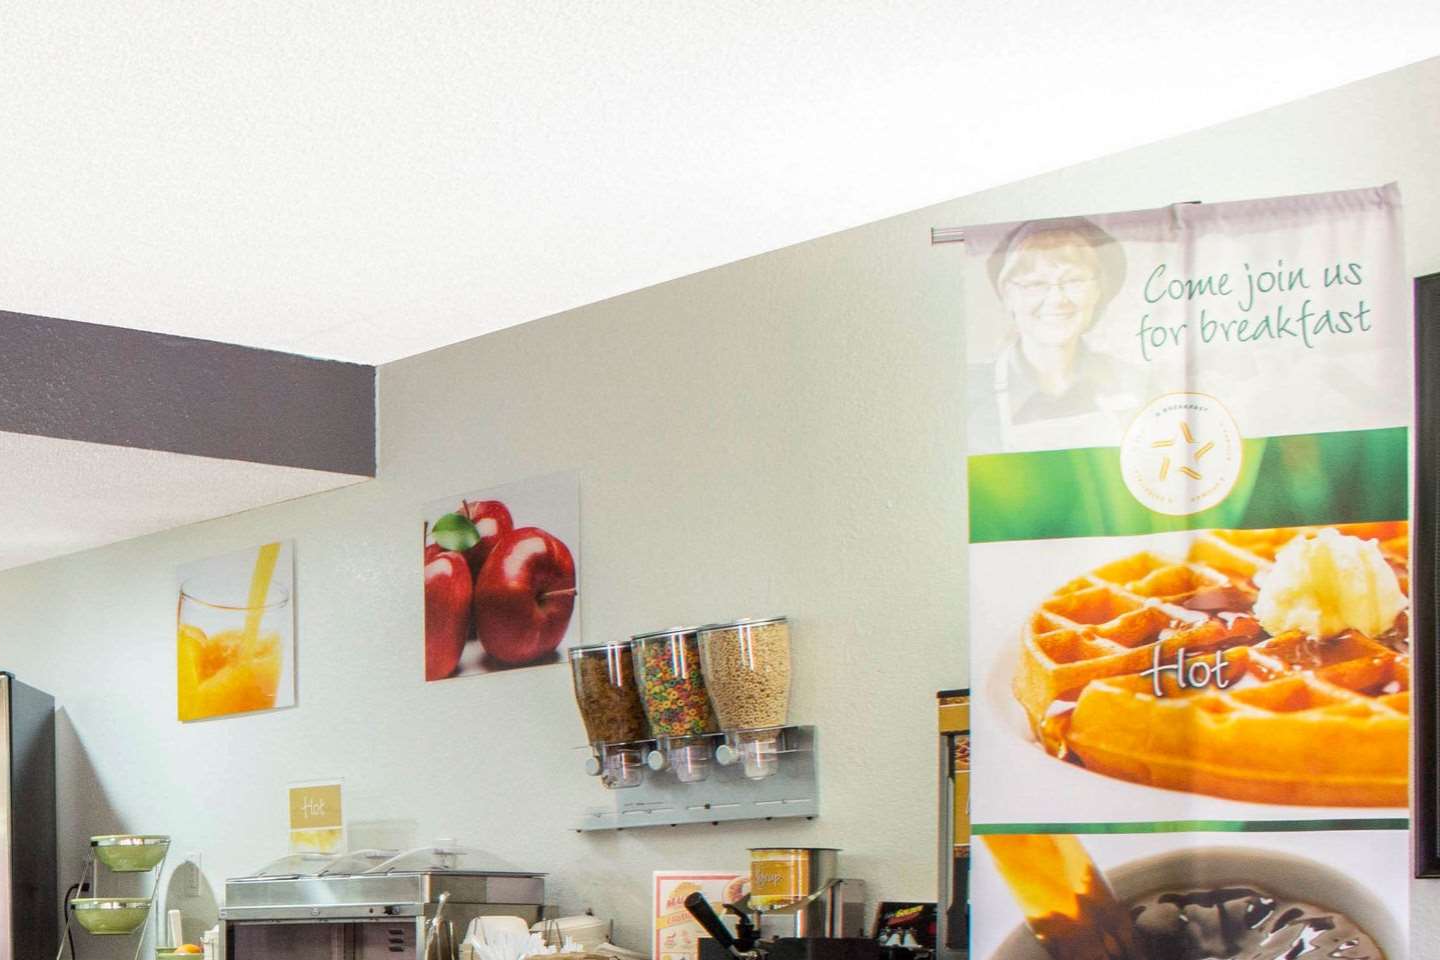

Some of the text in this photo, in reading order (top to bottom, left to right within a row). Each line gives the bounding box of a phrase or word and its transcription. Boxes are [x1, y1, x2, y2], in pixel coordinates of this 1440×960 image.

[1144, 260, 1363, 312] Come join us
[1135, 299, 1372, 361] for breakfast
[1139, 643, 1230, 698] Hot
